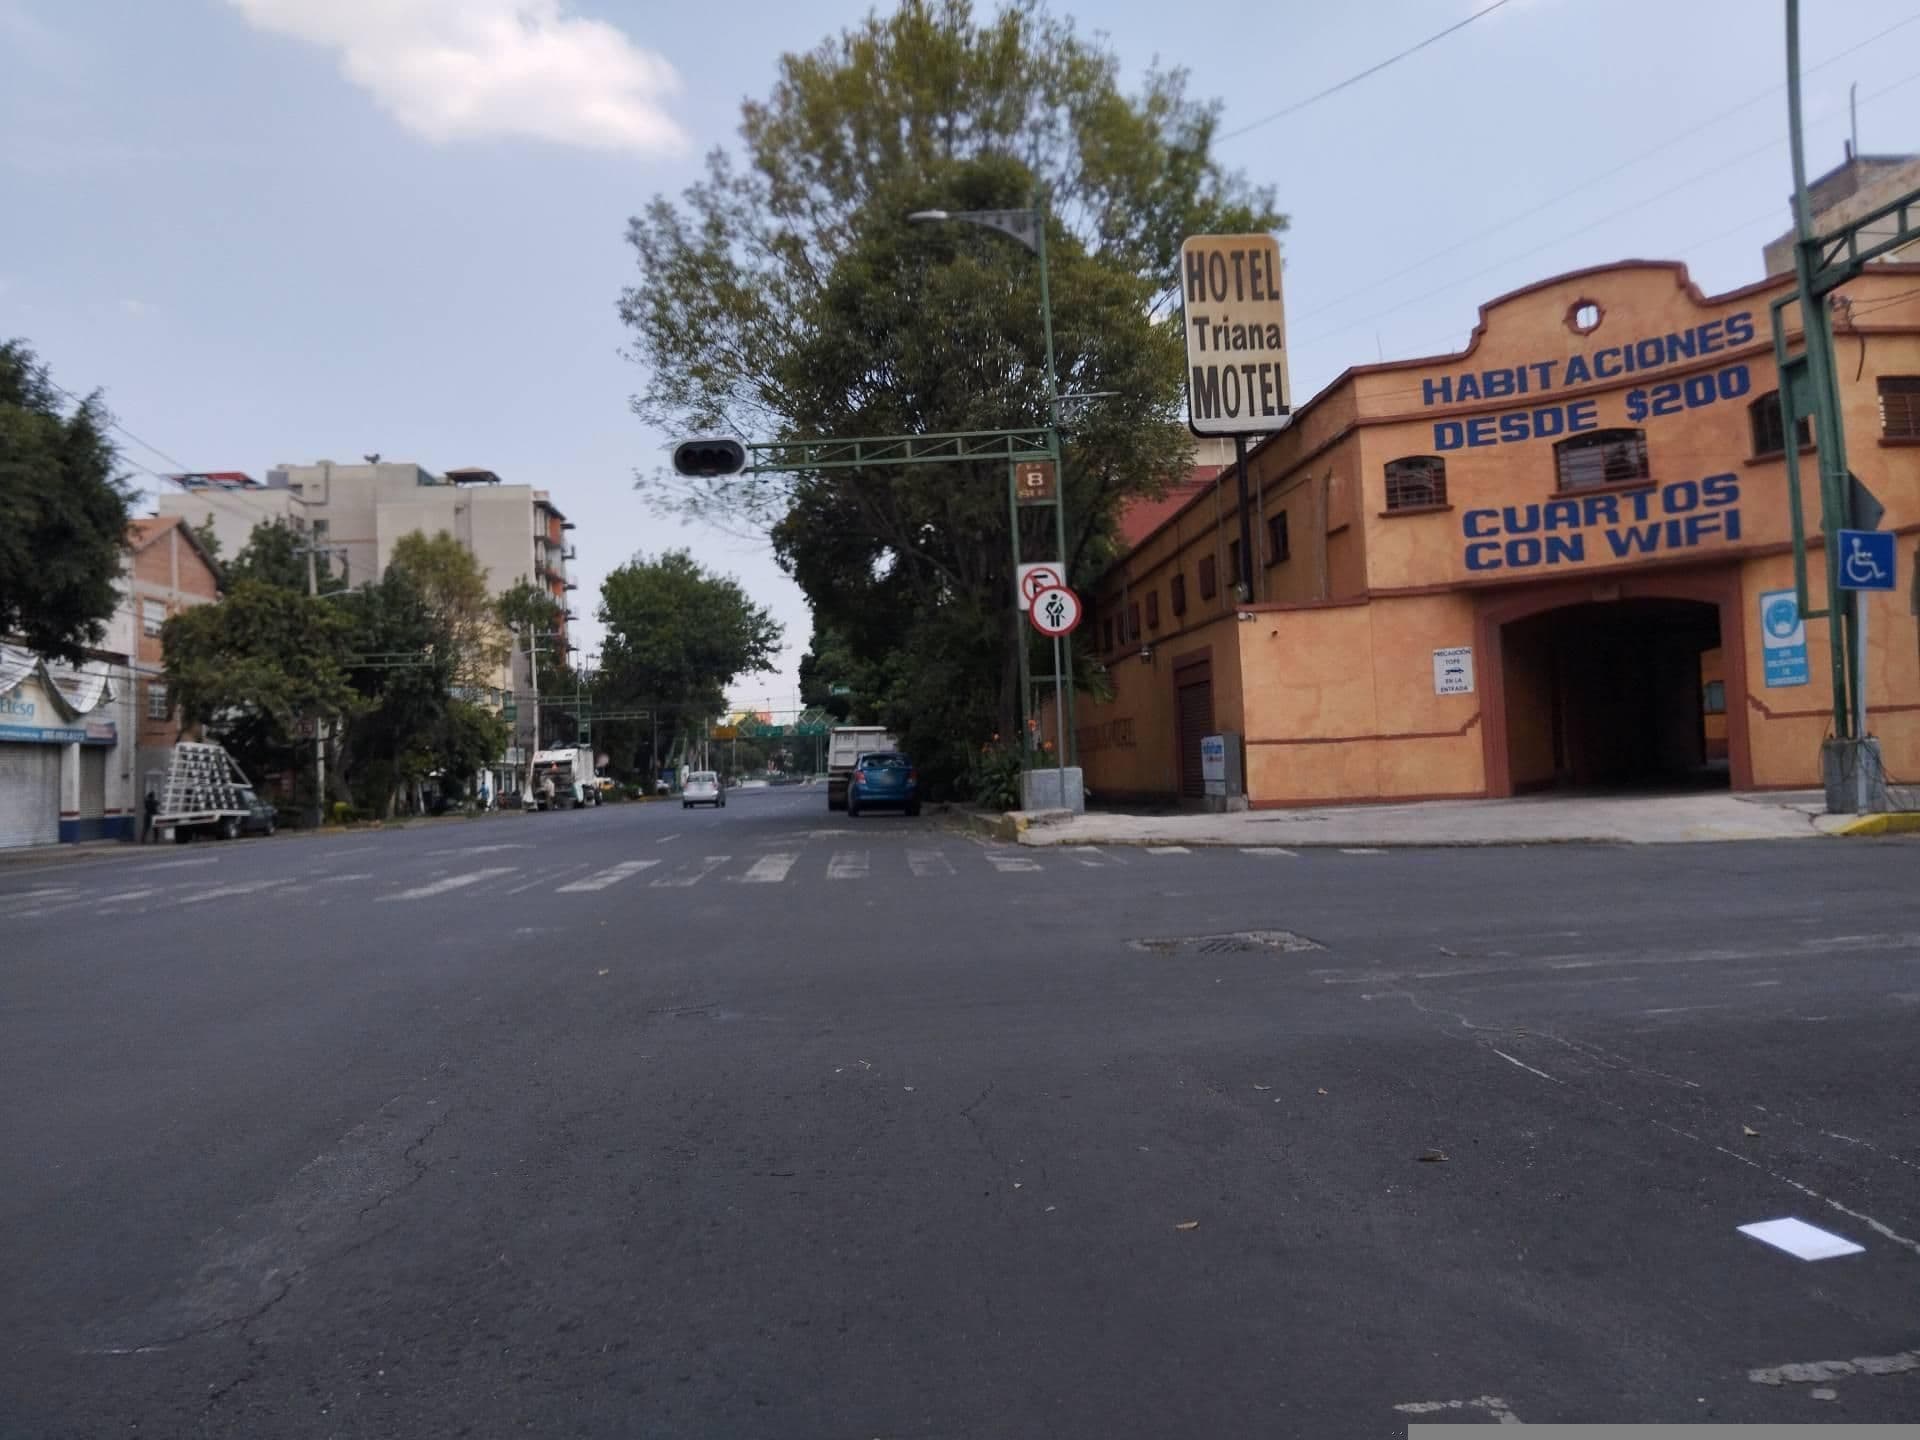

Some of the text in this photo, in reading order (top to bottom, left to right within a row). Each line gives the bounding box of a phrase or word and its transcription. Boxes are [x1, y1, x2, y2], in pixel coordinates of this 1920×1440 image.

[1186, 248, 1280, 303] HOTEL
[1192, 314, 1282, 351] Triana
[1422, 312, 1755, 405] HABITACIONES
[1192, 362, 1290, 419] MOTEL
[1433, 365, 1751, 451] DESDE $200
[1463, 472, 1740, 538] CUARTOS
[1464, 509, 1741, 571] CON WIFI
